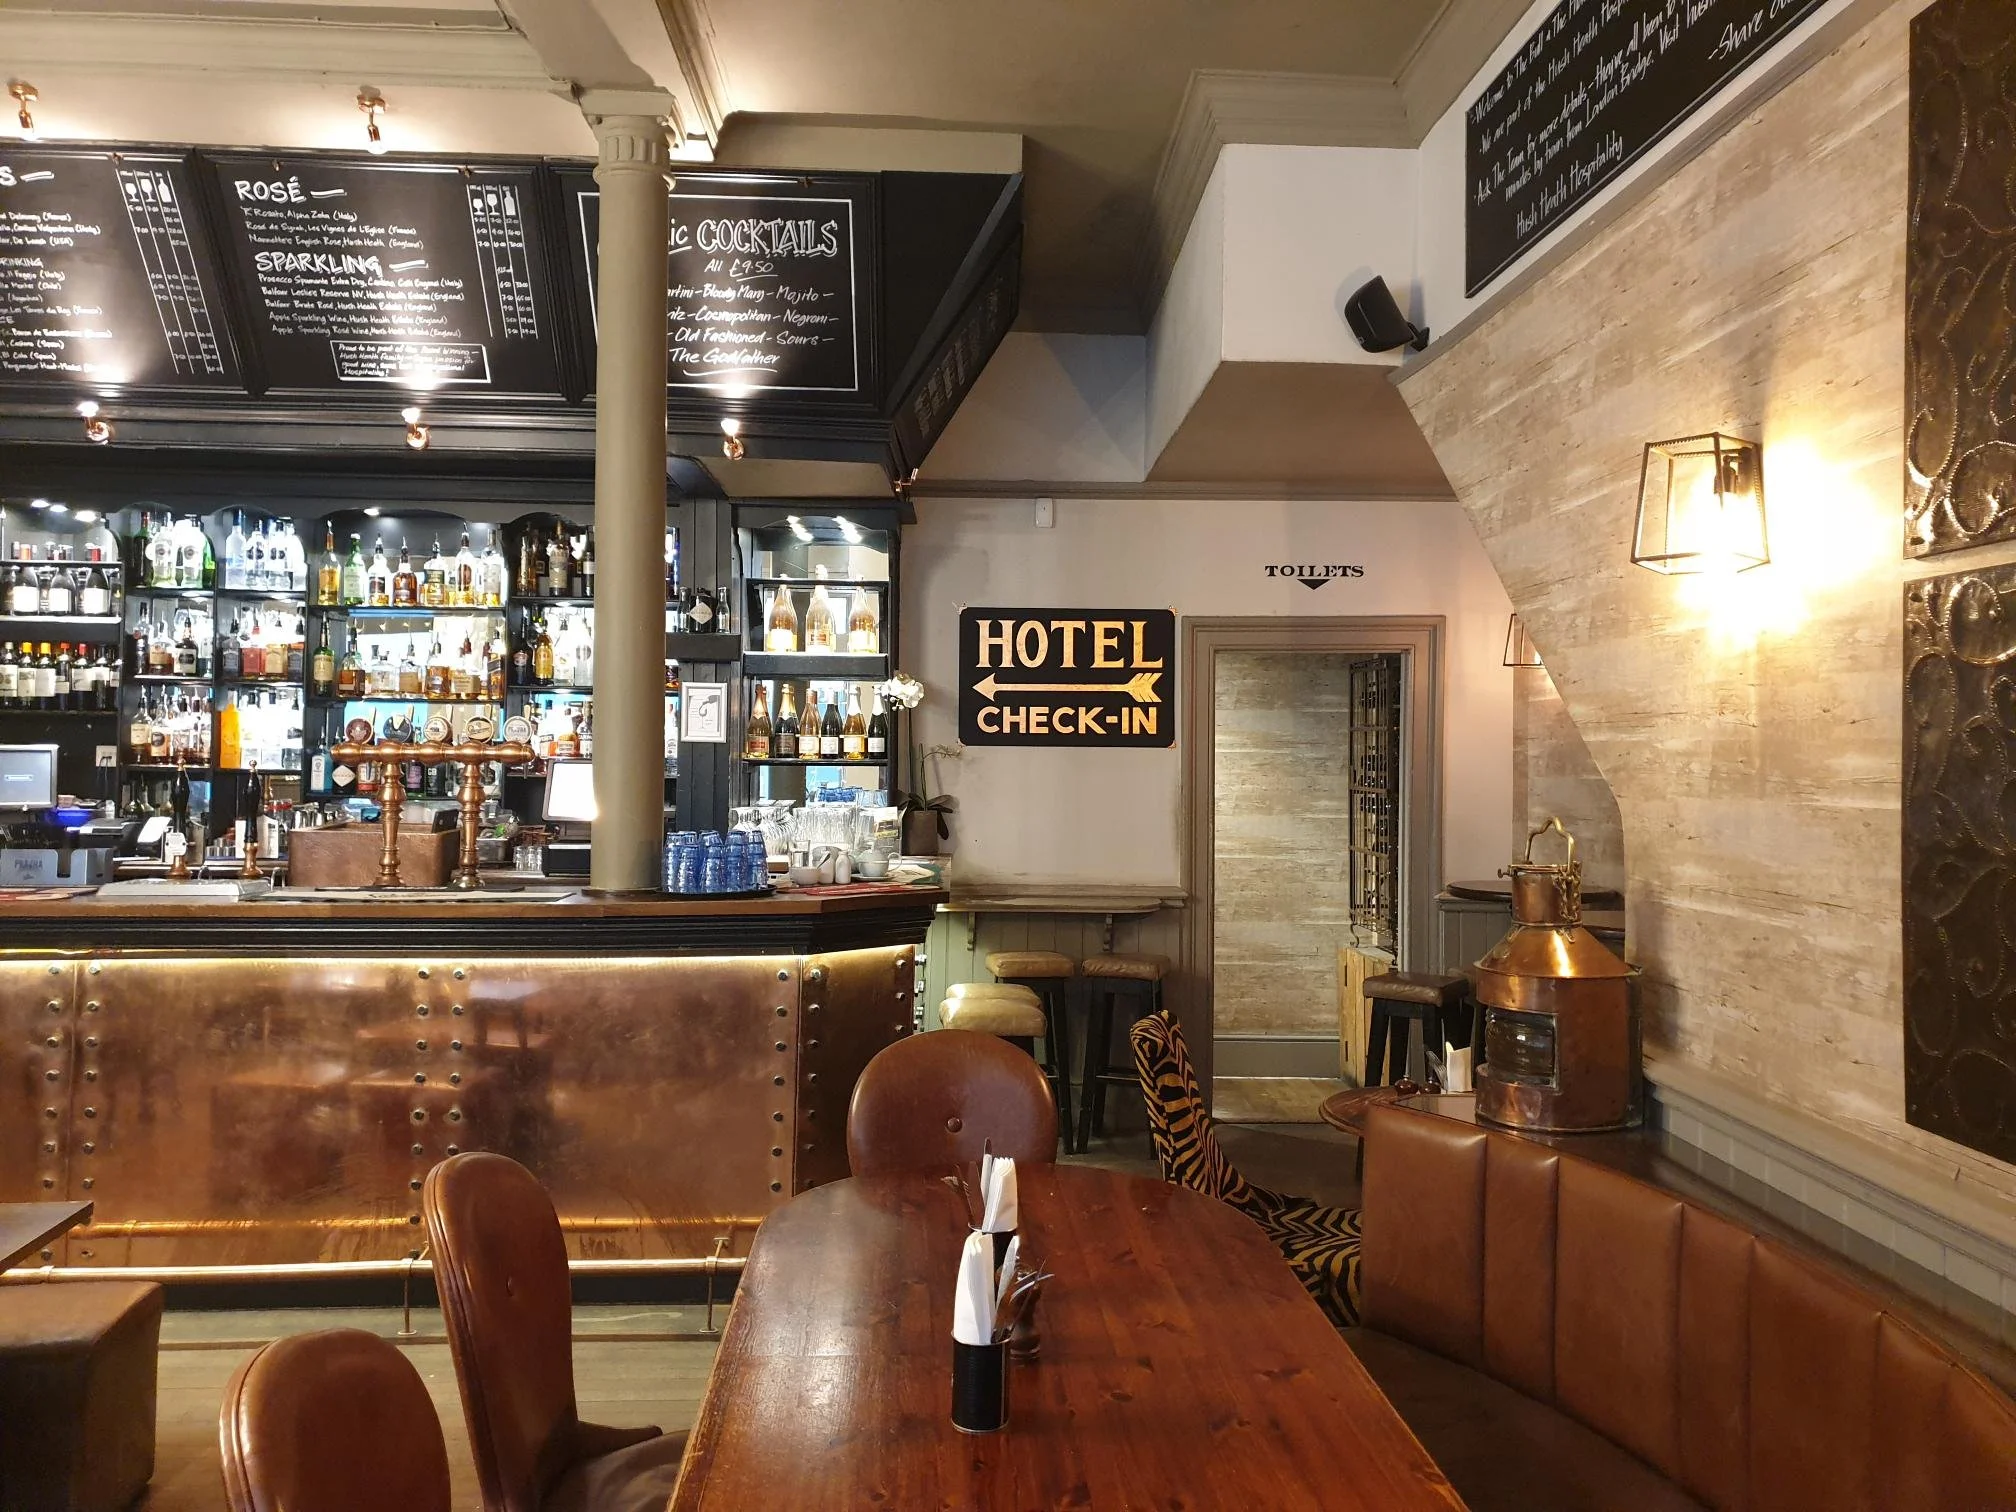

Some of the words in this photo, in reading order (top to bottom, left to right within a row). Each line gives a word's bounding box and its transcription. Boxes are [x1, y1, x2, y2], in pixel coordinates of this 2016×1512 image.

[1719, 9, 1764, 60] Share
[1475, 85, 1505, 123] Welcome
[1514, 56, 1528, 79] The
[1530, 31, 1543, 64] Bull
[1552, 12, 1567, 37] The
[1494, 122, 1505, 142] are
[1507, 100, 1521, 136] part
[1524, 86, 1532, 111] of
[1535, 76, 1546, 98] the
[1548, 48, 1570, 84] Hush
[1573, 16, 1598, 58] Heath
[1534, 151, 1543, 176] by
[1566, 118, 1583, 148] from
[1585, 83, 1618, 128] London
[1660, 13, 1680, 54] Visit
[1477, 178, 1492, 206] Ask
[1492, 161, 1505, 189] The
[1507, 147, 1524, 173] Team
[1527, 133, 1537, 159] for
[1540, 116, 1559, 144] more
[1560, 81, 1588, 123] details
[1626, 21, 1639, 56] all
[1643, 11, 1663, 43] been
[234, 175, 306, 203] ROSÉ
[1517, 202, 1538, 240] Hush
[1540, 173, 1567, 220] Heath
[1570, 130, 1622, 194] Hospitality
[321, 223, 346, 234] Vignes
[696, 218, 839, 257] COCKTAILS
[255, 252, 383, 277] SPARKLING
[704, 258, 724, 272] All
[258, 273, 292, 283] Prosecco
[667, 284, 695, 298] artini
[703, 283, 738, 302] Bloody
[738, 285, 765, 302] Mary
[776, 285, 819, 305] Mojito
[269, 311, 290, 322] Apple
[292, 313, 327, 325] Sparkling
[694, 305, 772, 326] Cosmopolitan
[782, 309, 828, 326] Negroni
[272, 324, 294, 335] Apple
[675, 327, 699, 342] Old
[702, 327, 767, 343] Fashioned
[776, 331, 818, 346] Sours
[669, 348, 700, 363] The
[703, 347, 781, 365] Godfather
[1265, 565, 1365, 579] TOILETS
[974, 619, 1164, 669] HOTEL
[976, 705, 1158, 736] CHECK-IN
